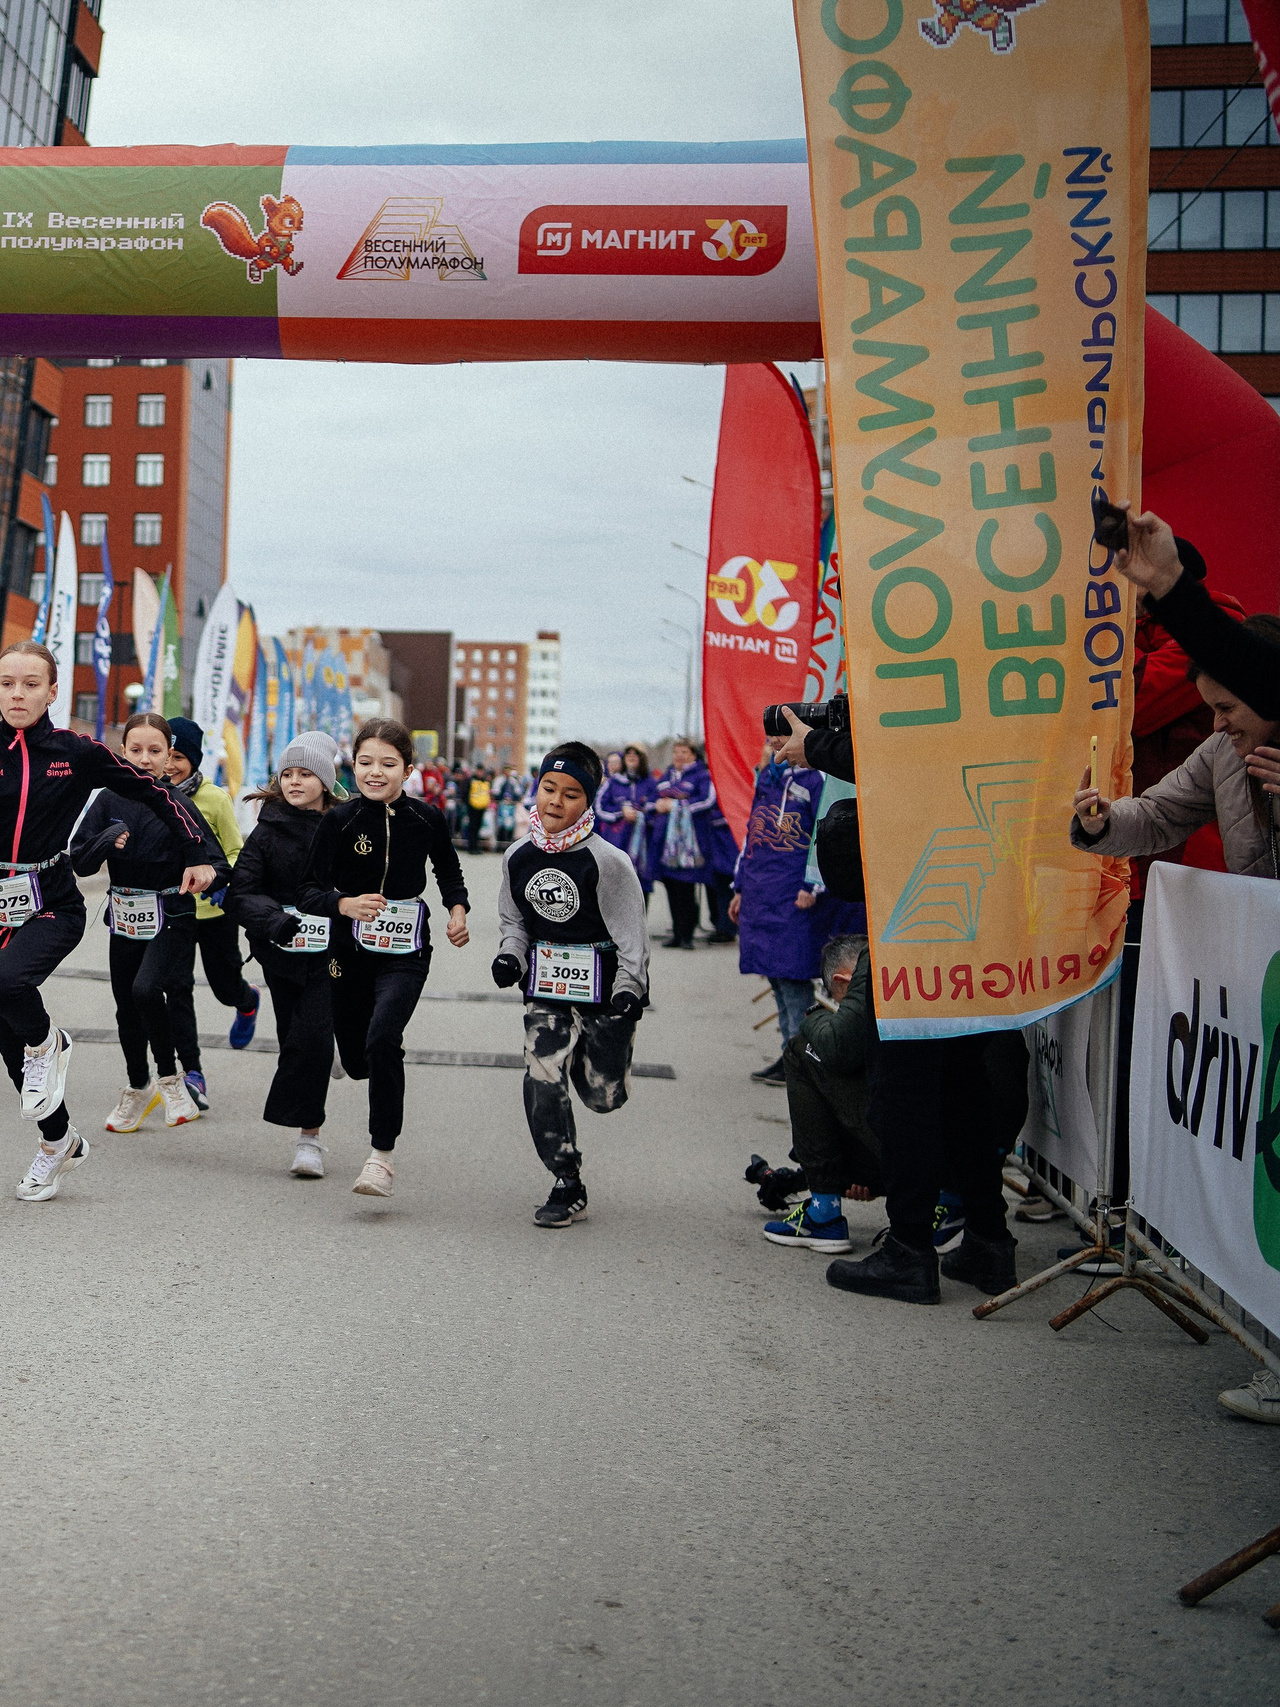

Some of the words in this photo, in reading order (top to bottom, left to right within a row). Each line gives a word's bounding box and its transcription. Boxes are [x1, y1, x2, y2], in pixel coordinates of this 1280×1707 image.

[2, 212, 33, 229] IX
[48, 211, 185, 229] Весенний
[1, 234, 184, 252] полумарафон
[363, 236, 447, 254] ВЕСЕННИЙ
[581, 229, 696, 250] МАГНИТ
[743, 235, 765, 245] лет
[363, 255, 484, 271] ПОЛУМАРАФОН
[46, 768, 73, 778] Sinyak
[49, 761, 70, 769] Alina
[122, 911, 155, 924] 3083
[299, 922, 327, 936] 096
[374, 919, 413, 935] 3069
[551, 965, 590, 981] 3093
